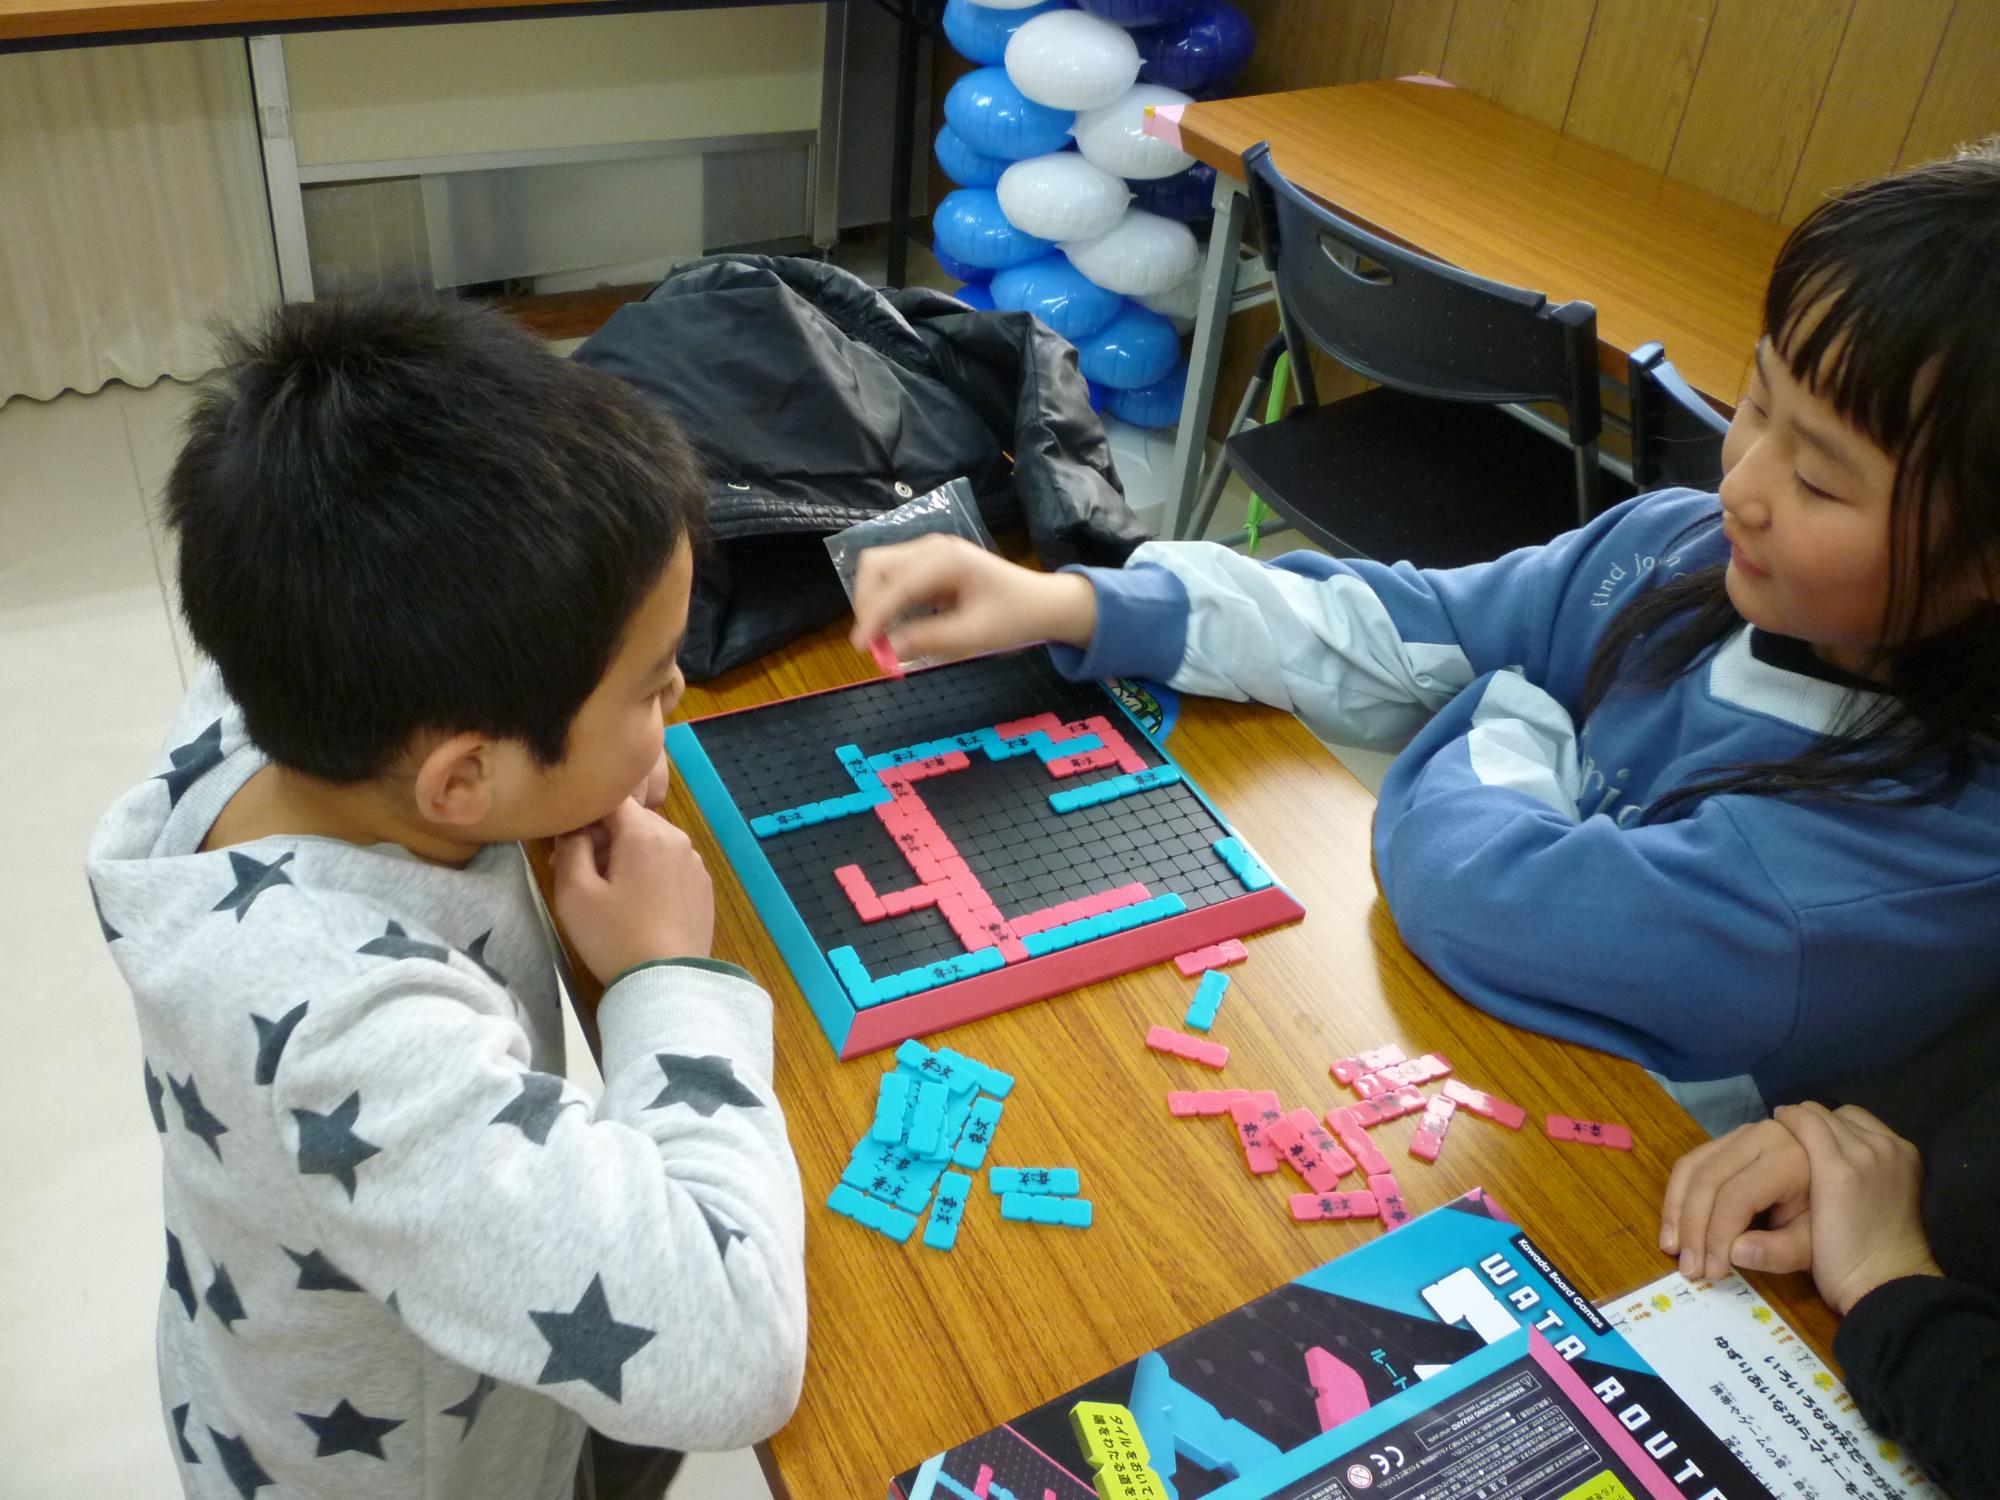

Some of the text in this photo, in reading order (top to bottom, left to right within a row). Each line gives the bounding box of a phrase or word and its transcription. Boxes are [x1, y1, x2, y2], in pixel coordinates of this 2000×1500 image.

[1480, 1253, 1586, 1361] WATA
[1518, 1239, 1604, 1328] Kawada Board Games
[1109, 1415, 1155, 1500] タイルをおいて
